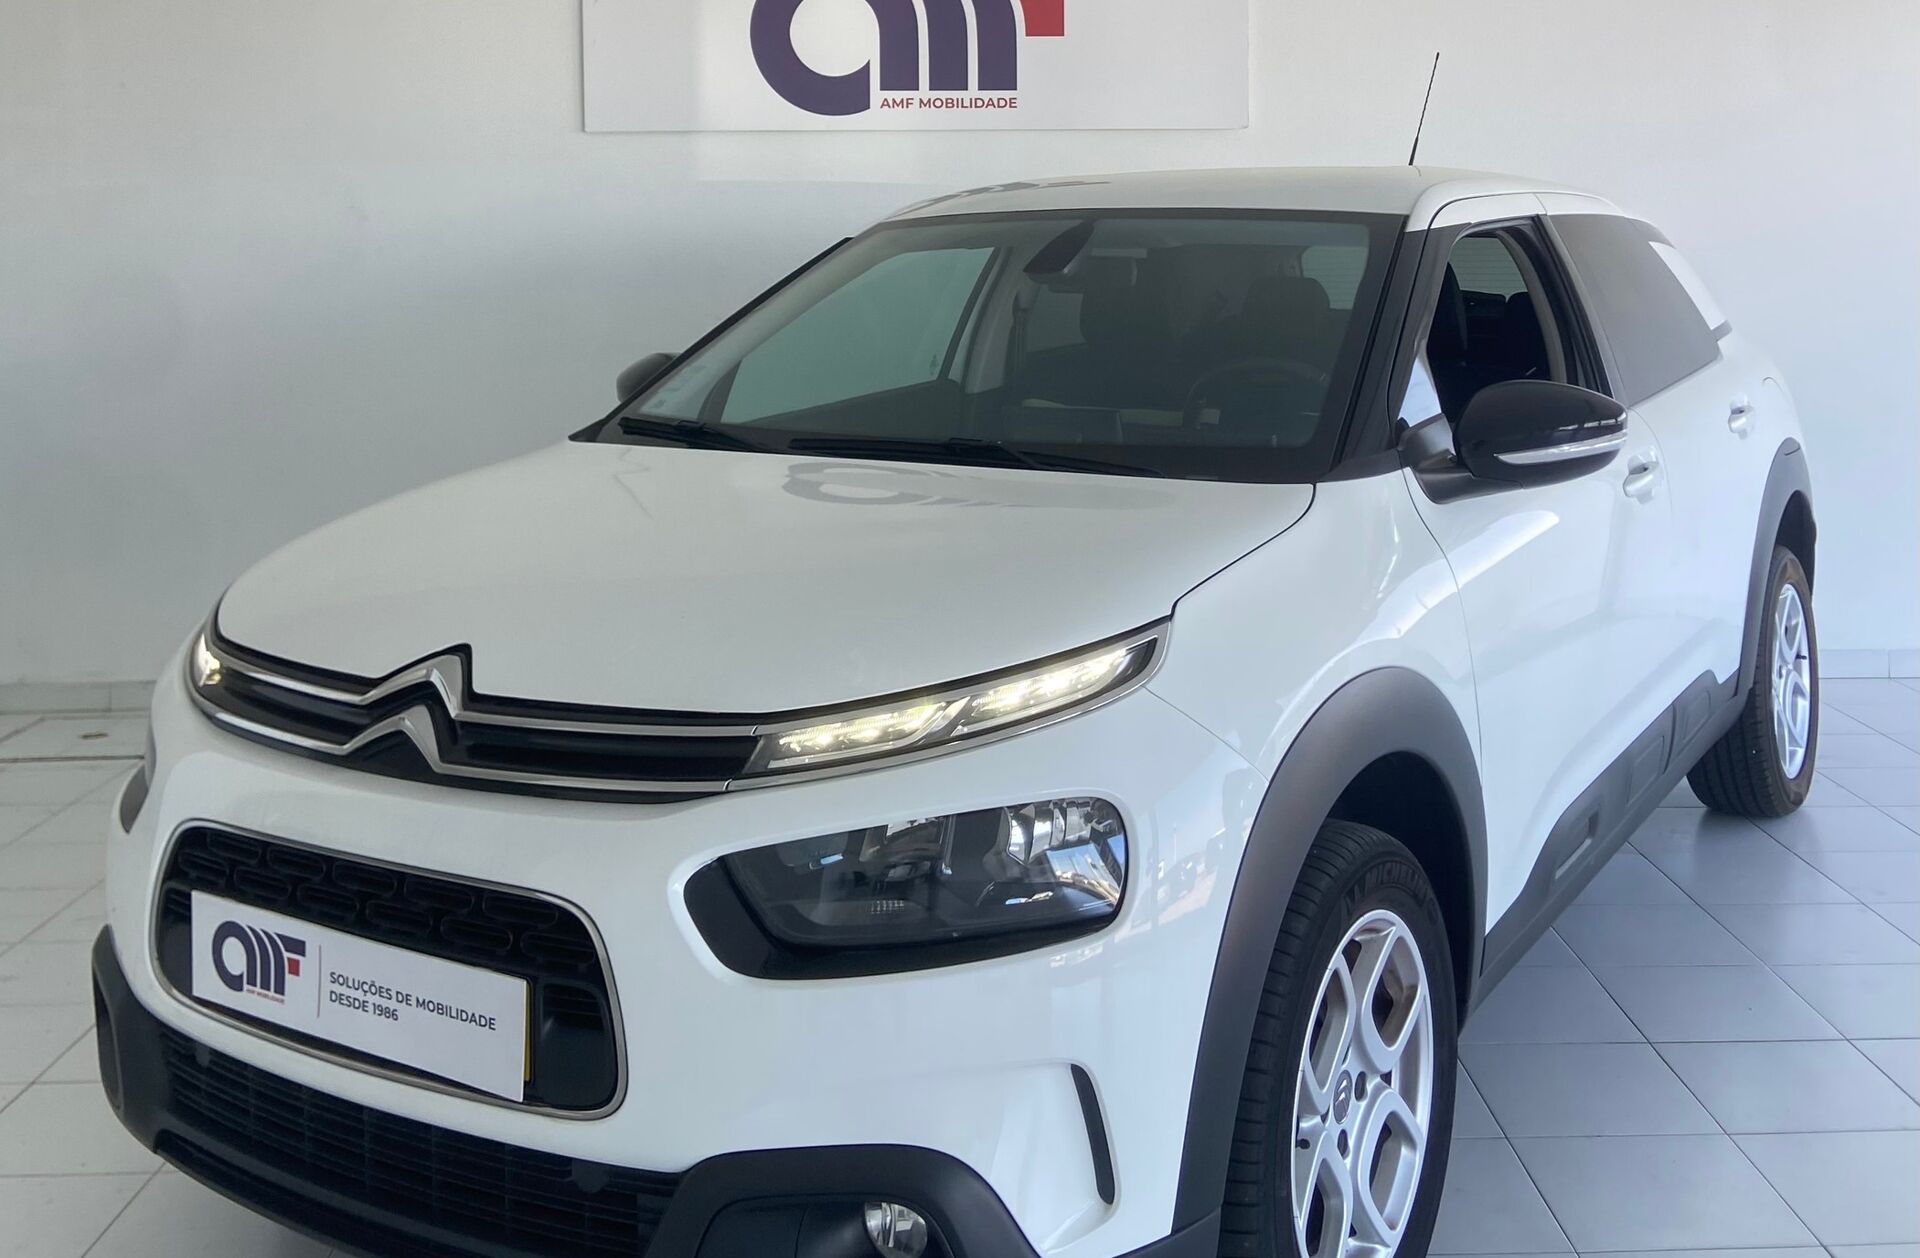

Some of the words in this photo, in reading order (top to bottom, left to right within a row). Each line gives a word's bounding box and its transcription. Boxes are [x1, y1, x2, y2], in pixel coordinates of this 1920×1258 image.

[880, 97, 914, 109] AMF
[919, 97, 1018, 109] MOBILIDADE
[329, 971, 393, 1000] SOLUÇÕES
[395, 990, 412, 1006] DE
[416, 996, 497, 1031] MOBILIDADE
[329, 990, 369, 1013] DESDE
[372, 1002, 399, 1021] 1986
